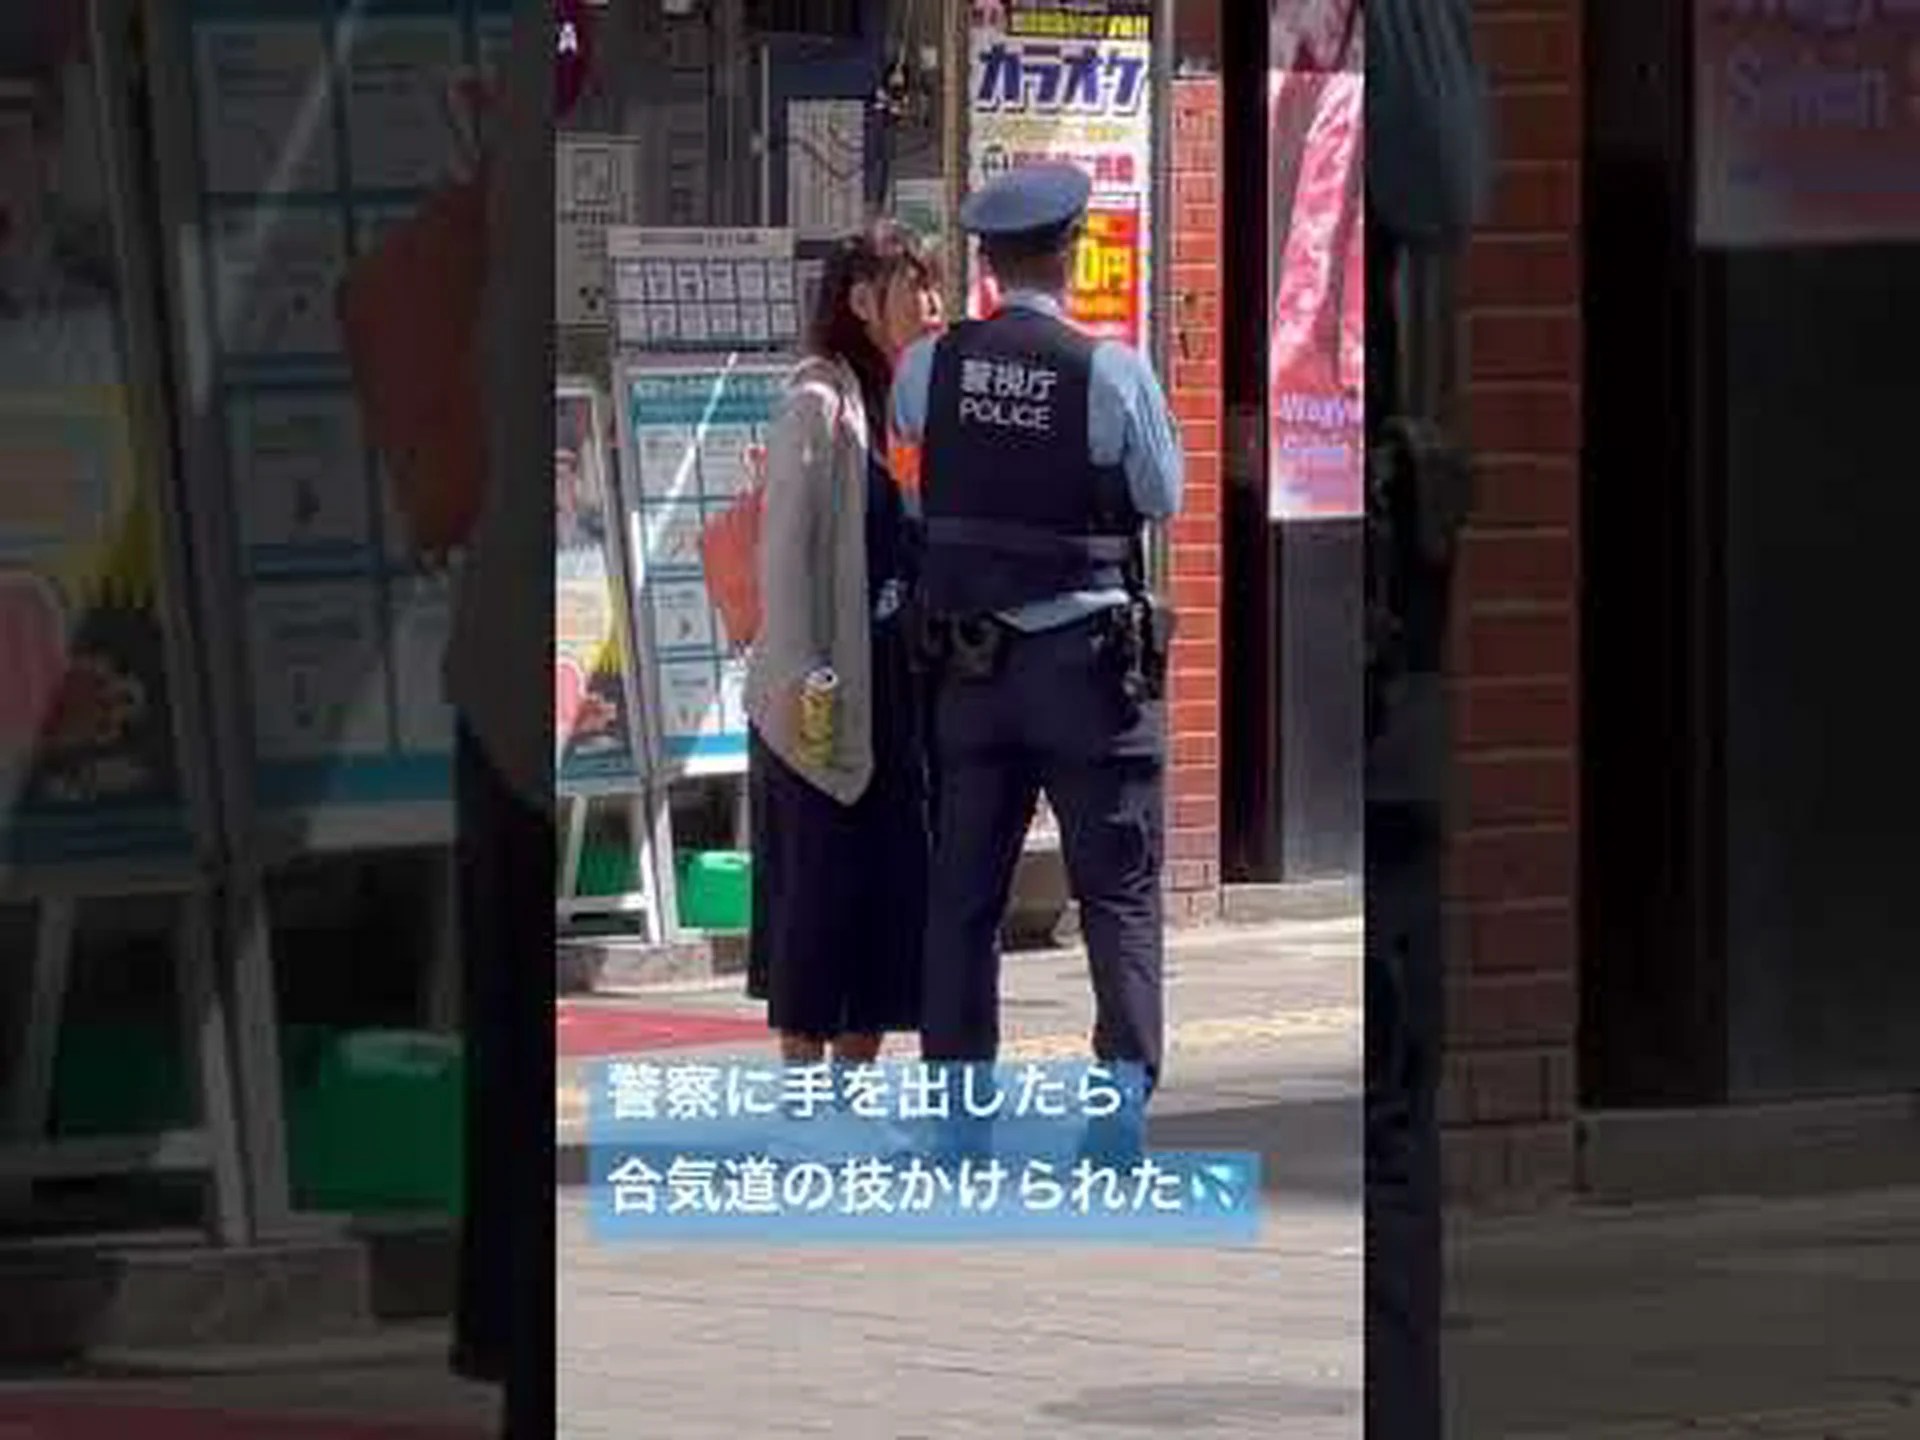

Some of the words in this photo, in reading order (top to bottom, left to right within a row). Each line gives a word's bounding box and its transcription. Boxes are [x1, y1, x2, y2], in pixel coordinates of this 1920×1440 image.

[976, 44, 1144, 113] カラオケ
[960, 397, 1051, 430] POLICE
